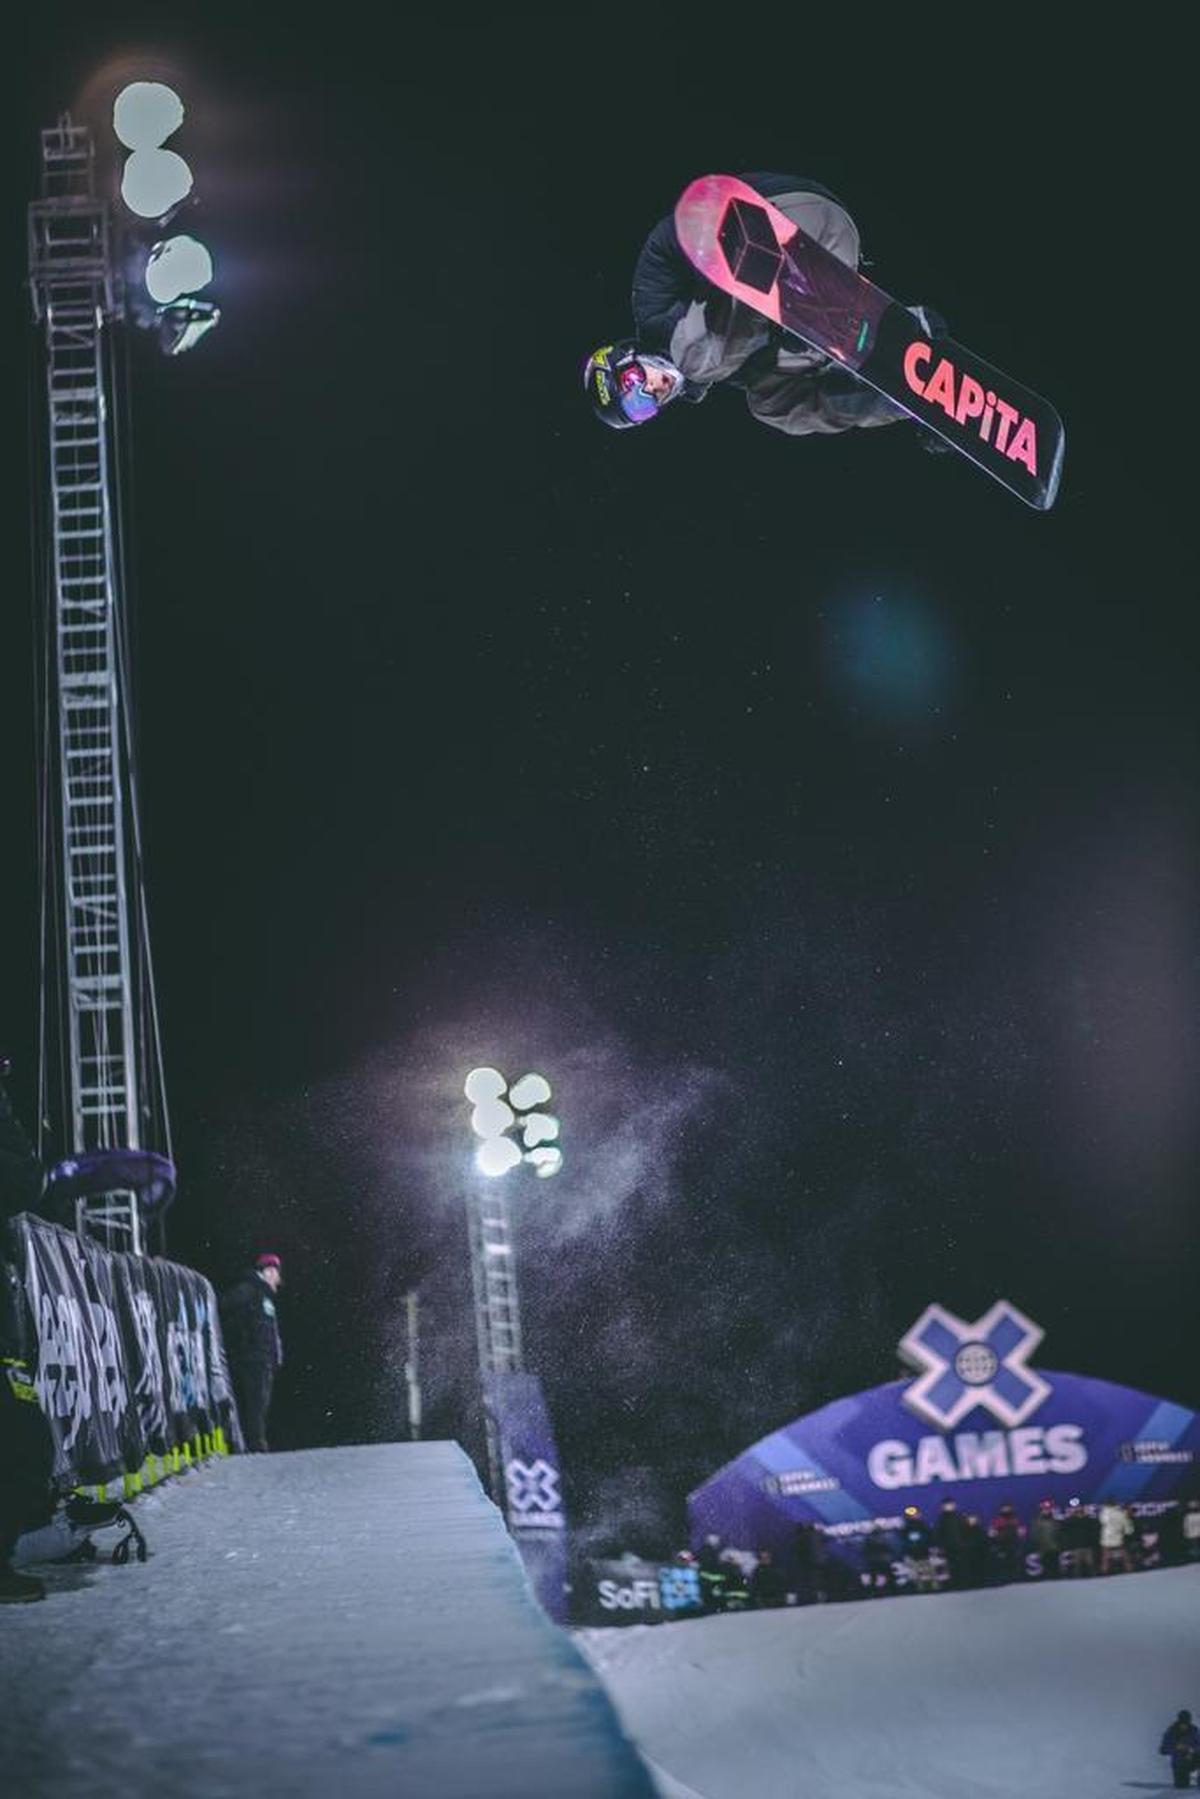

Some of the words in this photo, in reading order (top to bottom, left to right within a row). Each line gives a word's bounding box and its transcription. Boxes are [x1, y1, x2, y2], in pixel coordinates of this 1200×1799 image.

[904, 341, 1037, 477] CAPiTA
[868, 1423, 1089, 1490] GAMES
[598, 1580, 660, 1610] SoFi
